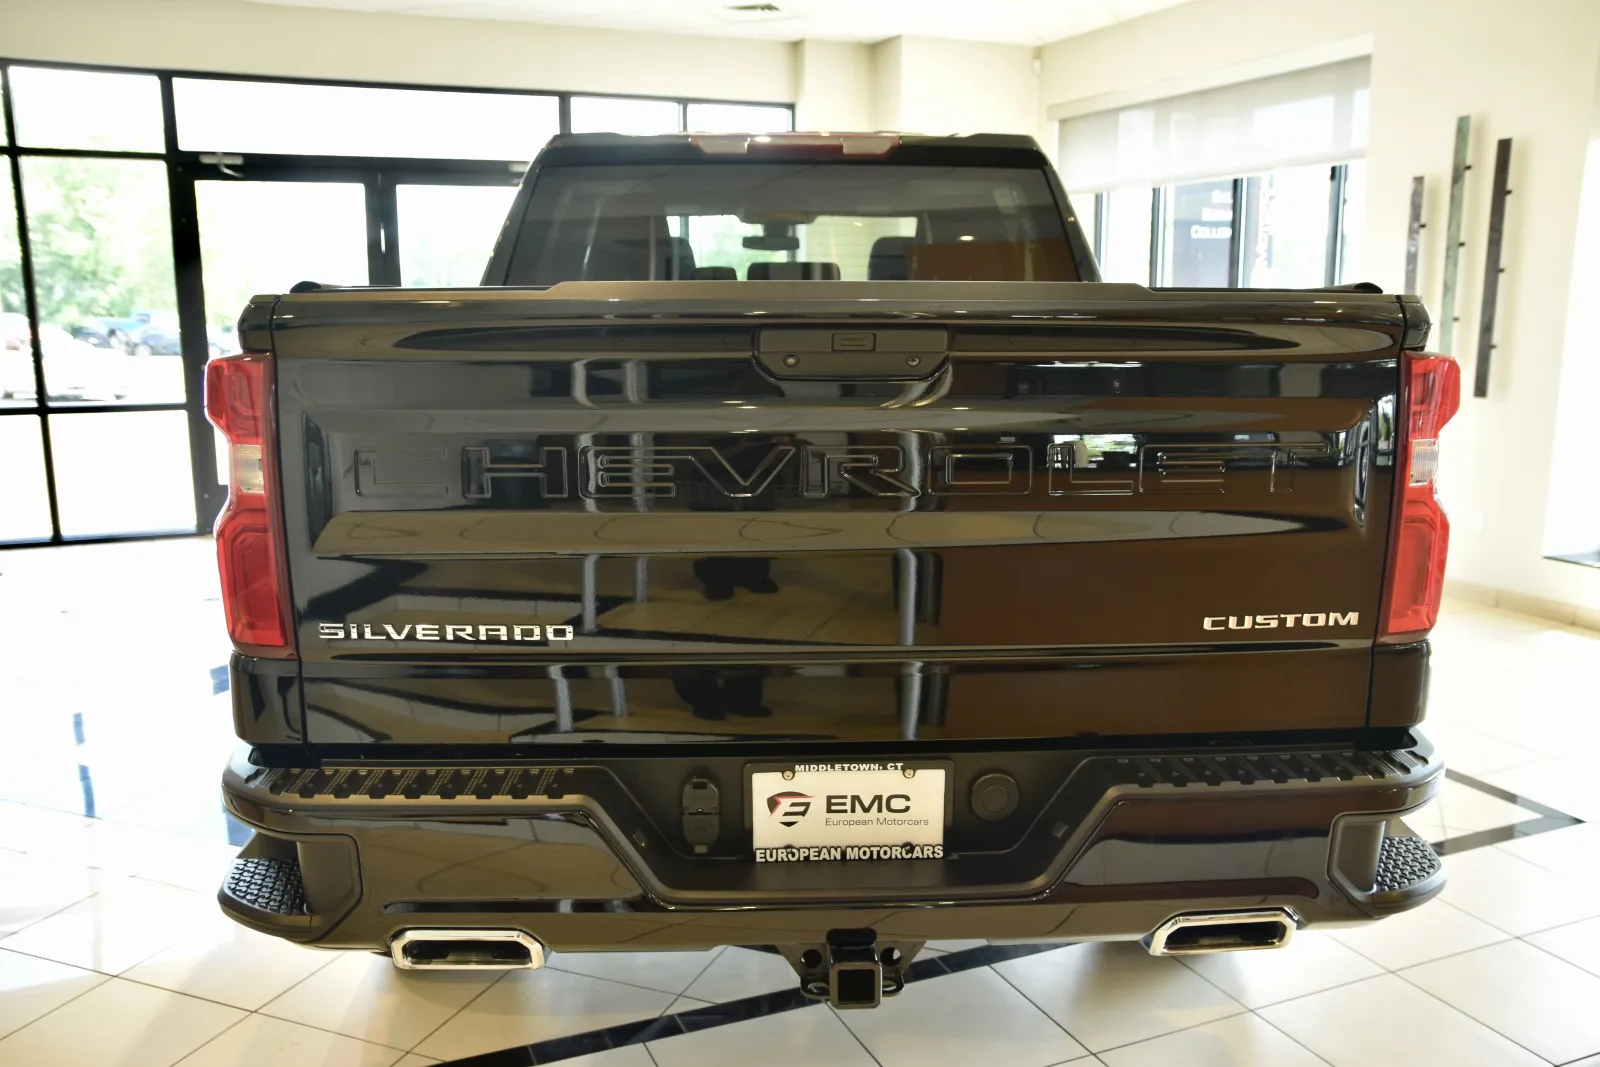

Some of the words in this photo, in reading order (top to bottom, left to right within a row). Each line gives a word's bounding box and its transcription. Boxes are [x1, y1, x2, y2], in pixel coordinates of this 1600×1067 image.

[354, 442, 1330, 500] CHEVROLET
[1203, 611, 1359, 631] CUSTOM
[318, 622, 575, 642] SILVERADO
[794, 763, 883, 772] MIDDLETOWN,
[886, 762, 904, 771] CT
[825, 794, 911, 814] EMC
[825, 817, 874, 827] European
[876, 817, 930, 826] Motorcars
[755, 847, 842, 863] EUROPEAN
[846, 845, 944, 860] MOTORCARS
